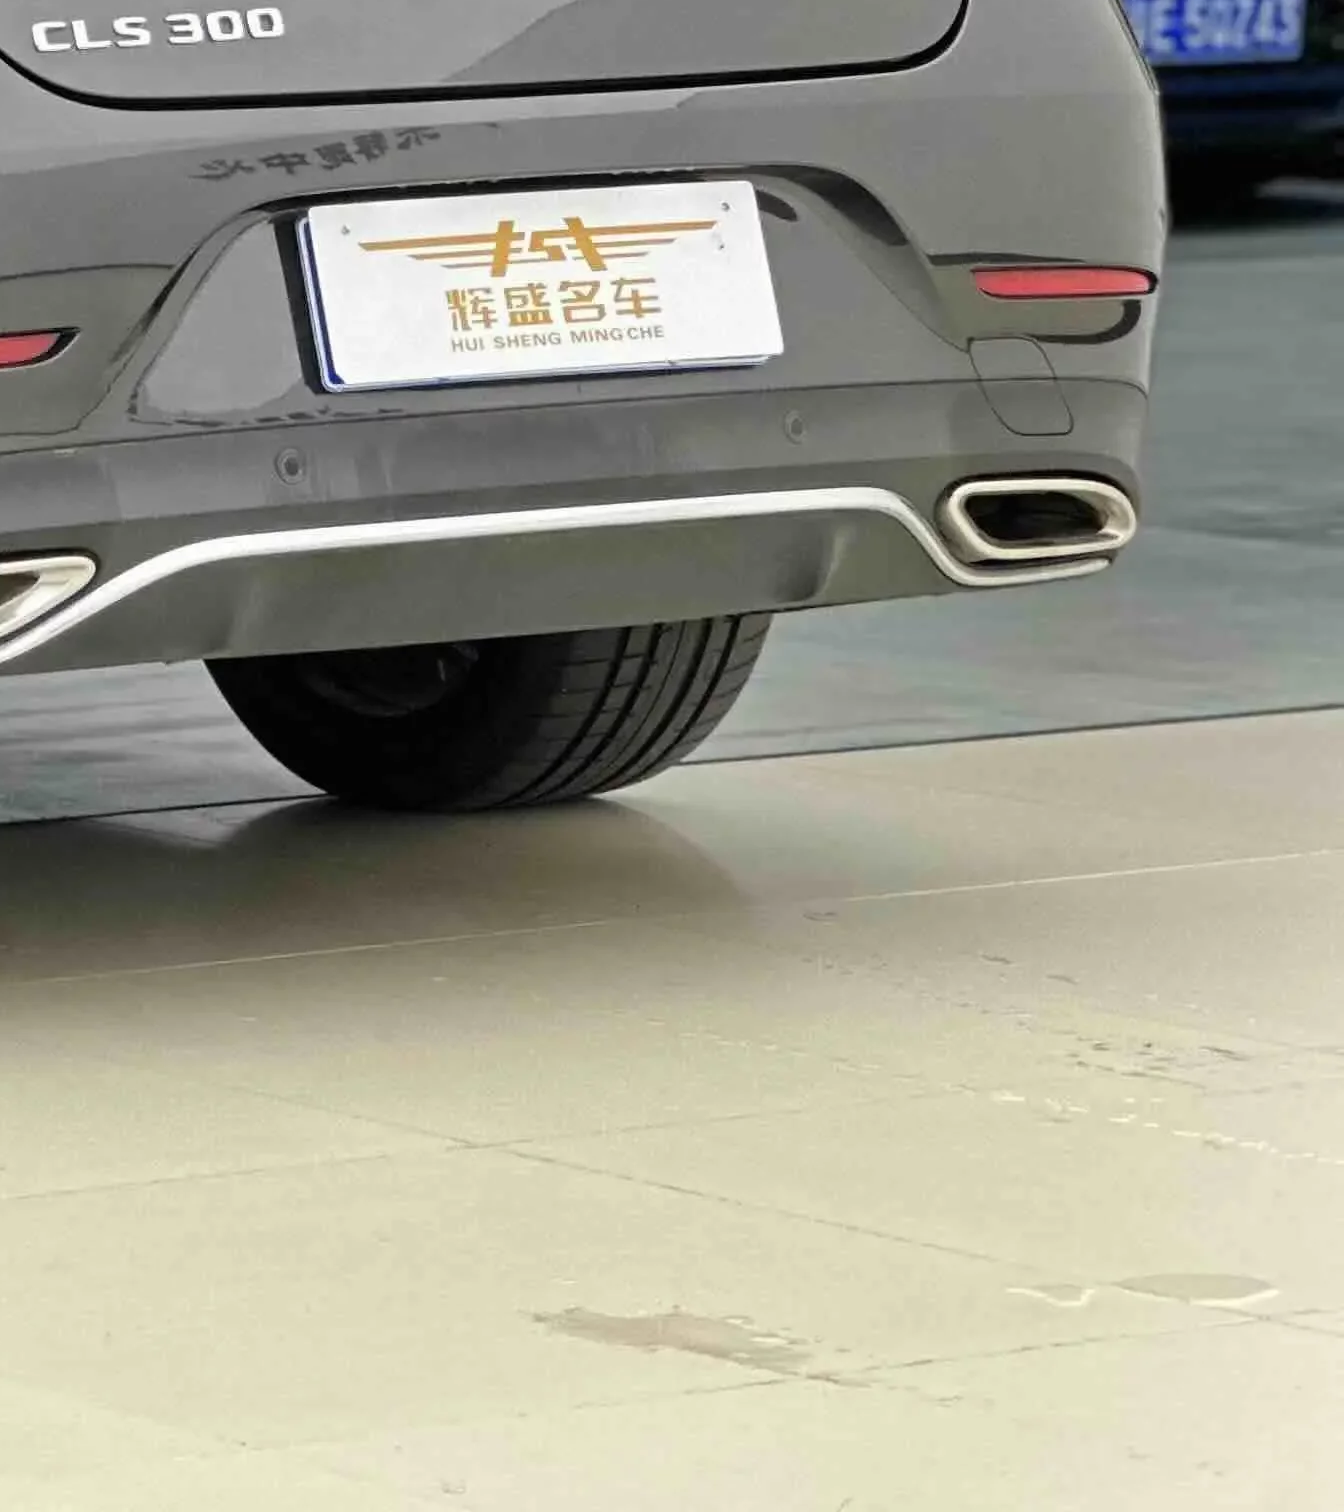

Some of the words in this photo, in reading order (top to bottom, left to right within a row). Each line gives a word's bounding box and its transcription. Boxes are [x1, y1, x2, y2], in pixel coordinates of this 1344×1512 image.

[32, 17, 152, 52] CLS
[165, 7, 285, 45] 300
[445, 277, 662, 331] 辉盛名车
[451, 338, 485, 353] HUI
[493, 331, 562, 350] SHENG
[570, 326, 624, 345] MING
[626, 324, 665, 340] CHE
